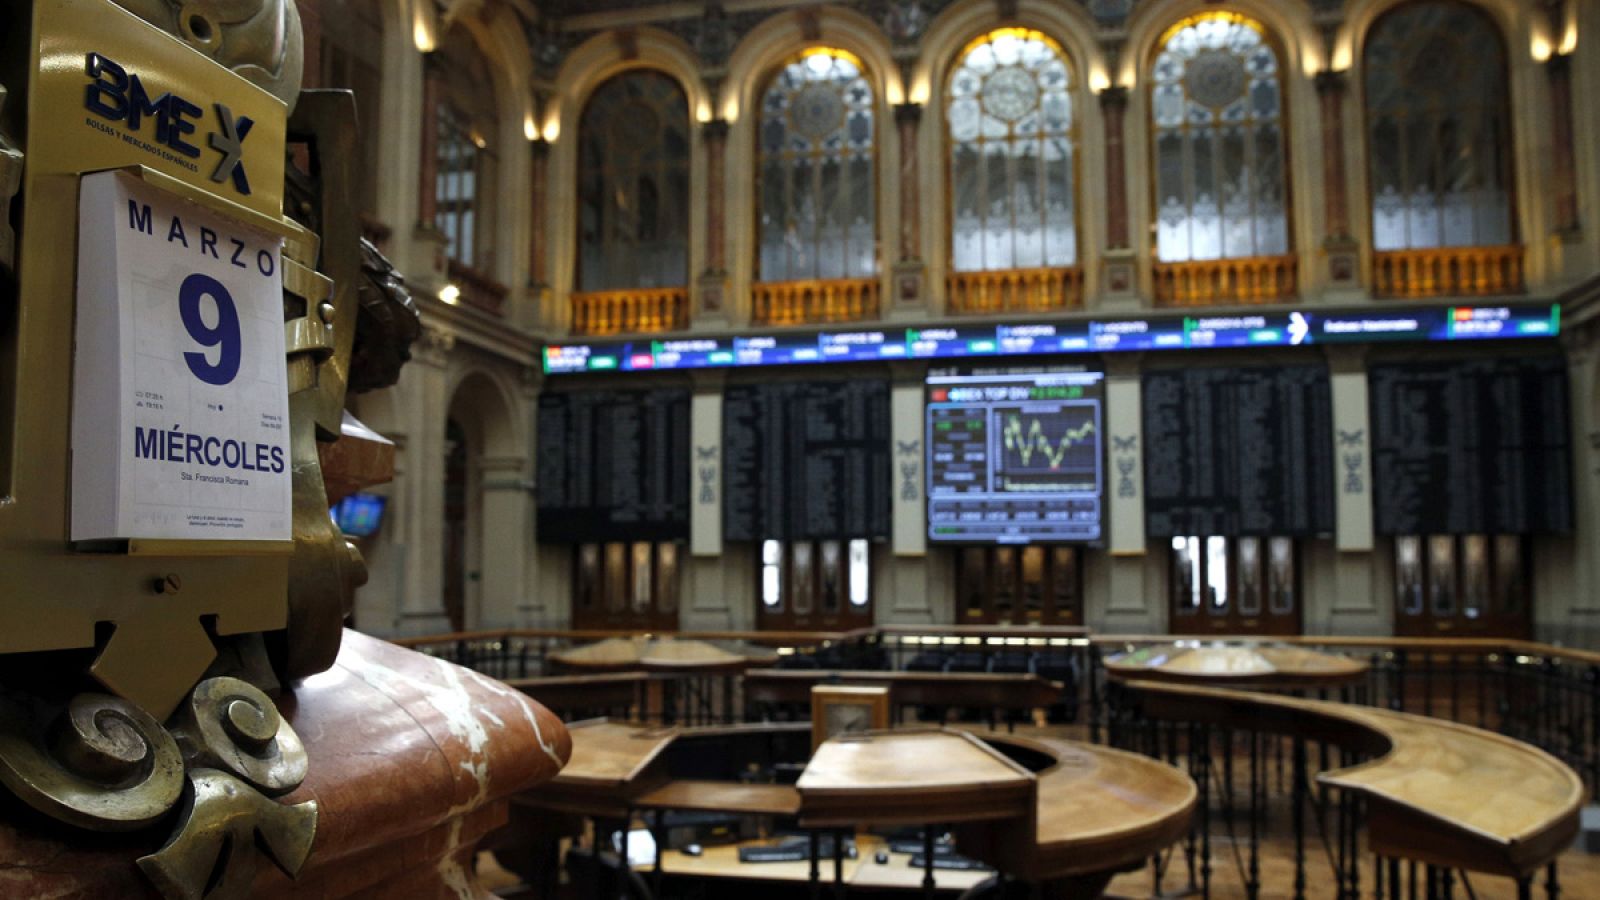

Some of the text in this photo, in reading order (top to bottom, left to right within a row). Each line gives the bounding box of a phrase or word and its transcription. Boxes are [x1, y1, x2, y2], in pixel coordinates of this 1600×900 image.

[86, 118, 115, 136] BOLSAS
[122, 134, 161, 156] MERCADOS
[127, 198, 275, 278] MARZO
[178, 272, 242, 386] 9
[135, 424, 285, 474] MIÉRCOLES
[195, 472, 225, 484] Francisca
